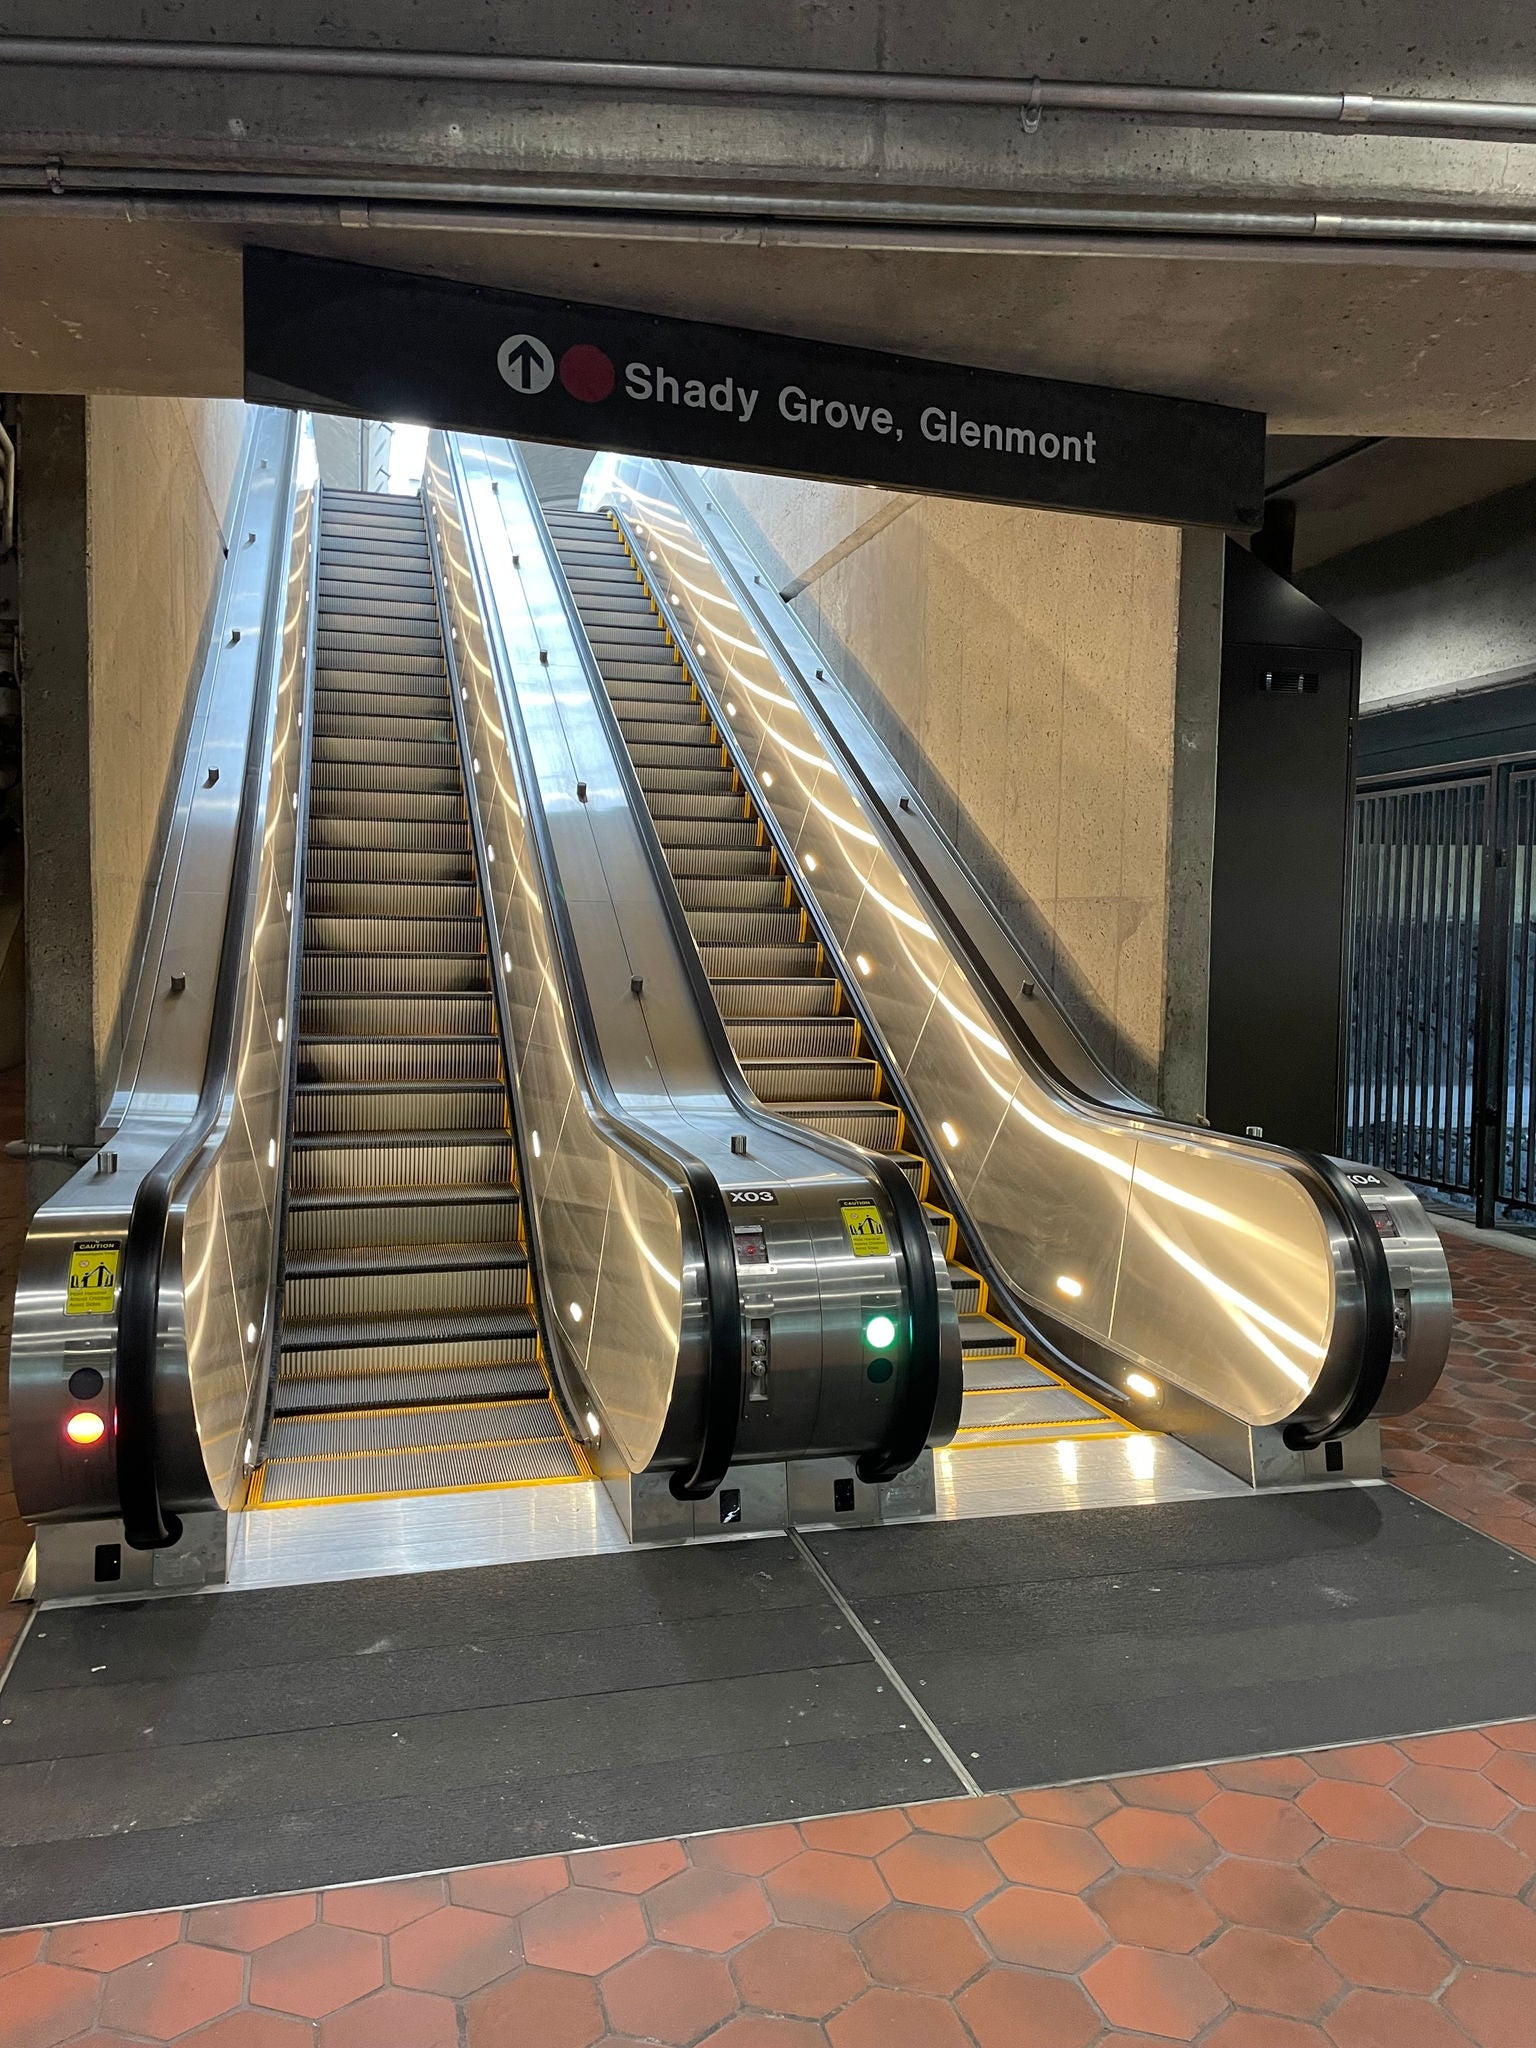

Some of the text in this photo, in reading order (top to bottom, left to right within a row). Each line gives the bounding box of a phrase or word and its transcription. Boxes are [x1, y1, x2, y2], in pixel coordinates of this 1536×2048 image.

[625, 362, 1097, 464] Shady Grove, Glenmont
